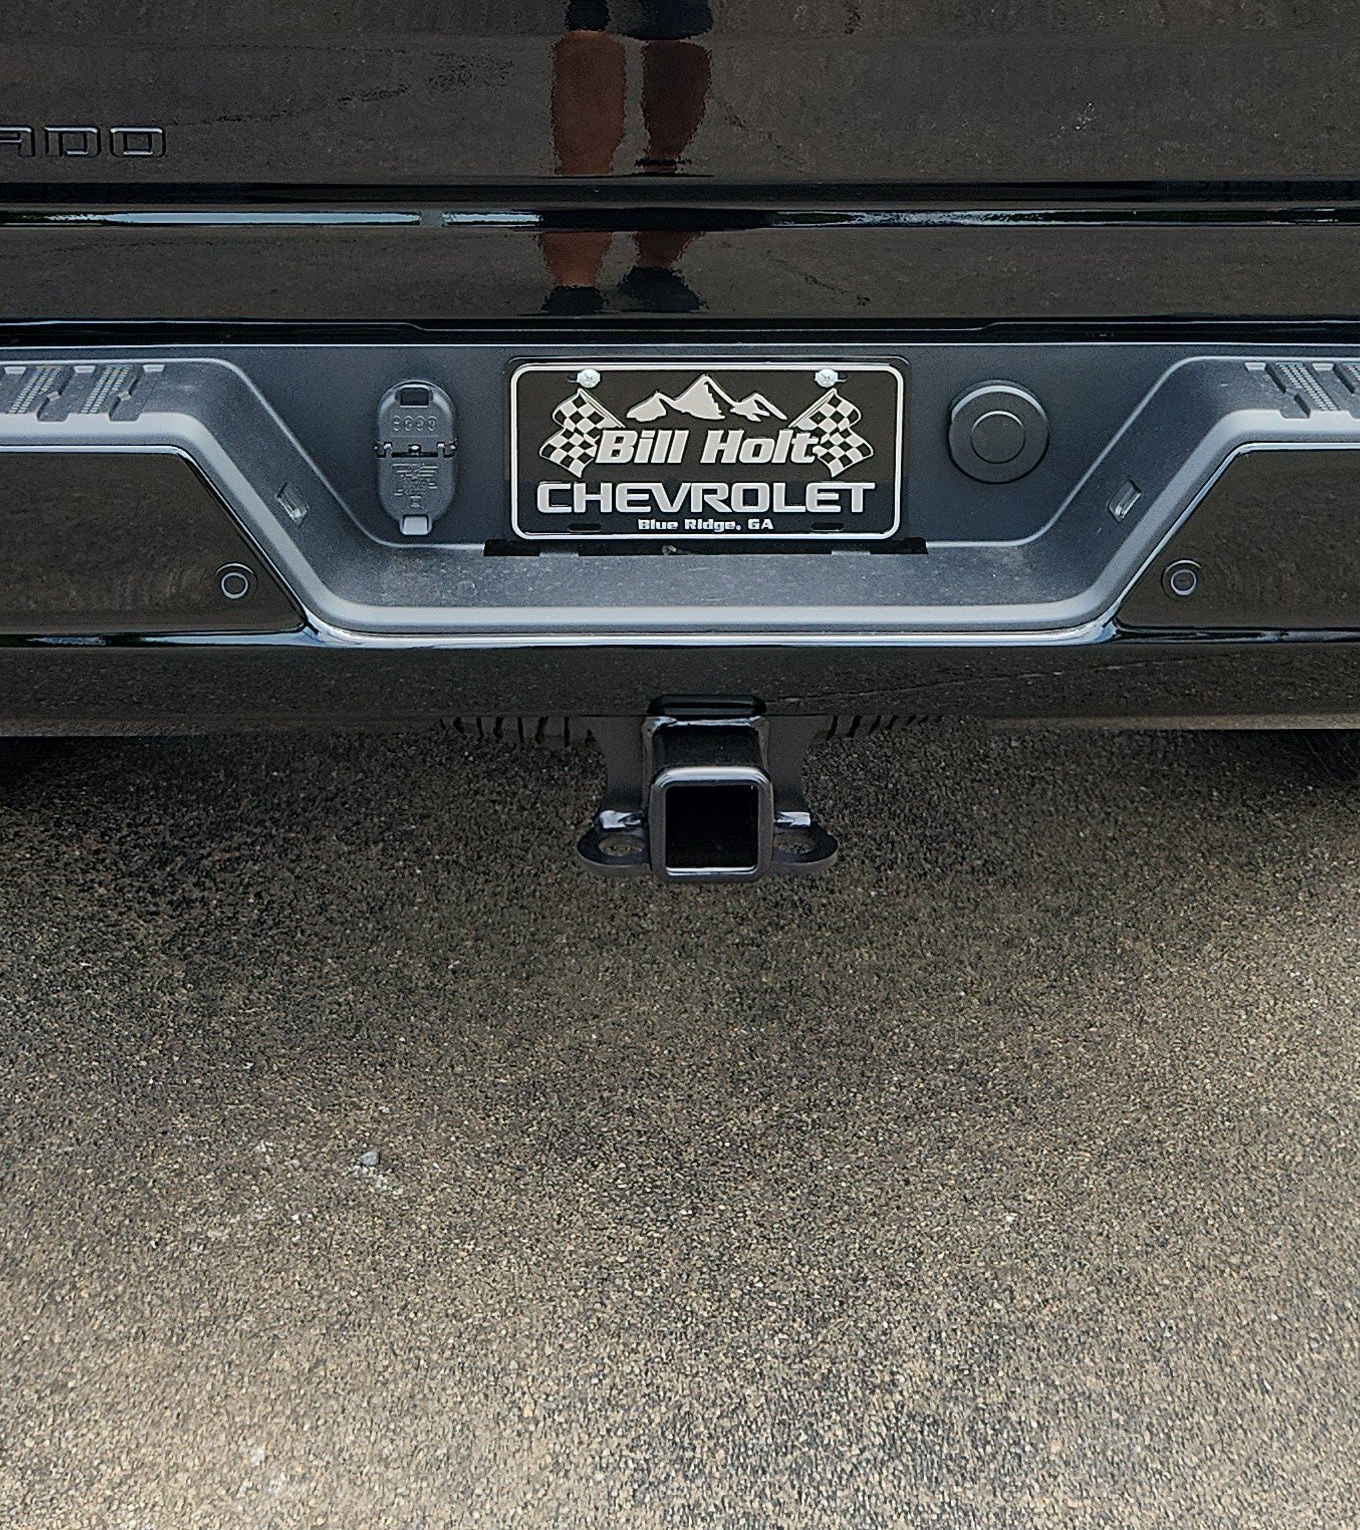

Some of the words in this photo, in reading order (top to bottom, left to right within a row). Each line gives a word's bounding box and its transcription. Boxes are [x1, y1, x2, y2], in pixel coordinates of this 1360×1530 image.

[595, 429, 690, 464] Bill
[700, 428, 820, 464] Holt
[536, 481, 876, 513] CHEVROLET
[638, 518, 679, 530] Blue
[747, 518, 774, 530] GA
